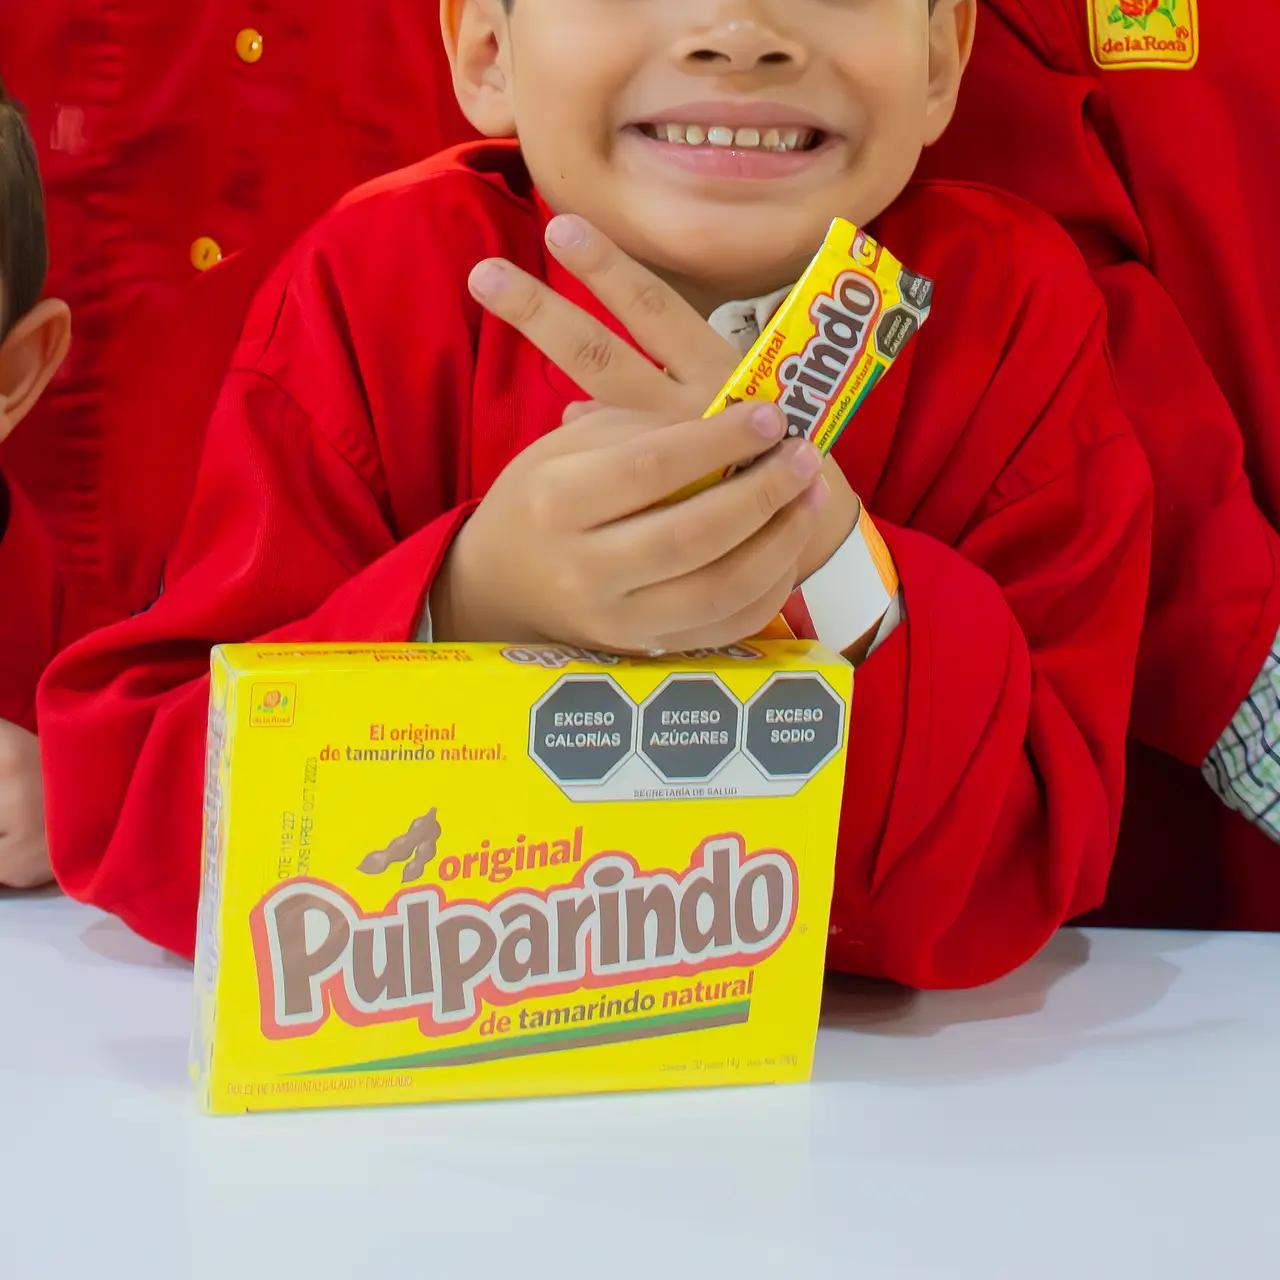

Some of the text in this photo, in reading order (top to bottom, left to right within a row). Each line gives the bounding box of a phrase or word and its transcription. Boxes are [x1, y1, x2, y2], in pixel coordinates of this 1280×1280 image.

[1143, 35, 1187, 52] Rosa
[745, 330, 787, 397] original
[786, 276, 876, 441] arindo
[818, 353, 874, 449] amarindo natural
[554, 711, 615, 727] EXCESO
[661, 709, 721, 725] EXCESO
[765, 707, 824, 723] EXCESO
[369, 723, 456, 745] El original
[544, 730, 621, 748] CALORÍAS
[649, 728, 728, 746] AZÚCARES
[770, 728, 815, 744] SODIO
[319, 743, 341, 761] de
[346, 745, 436, 761] tamarindo
[437, 825, 585, 884] original
[266, 842, 790, 1023] Pulparindo
[478, 970, 755, 1037] de tamarindo natural
